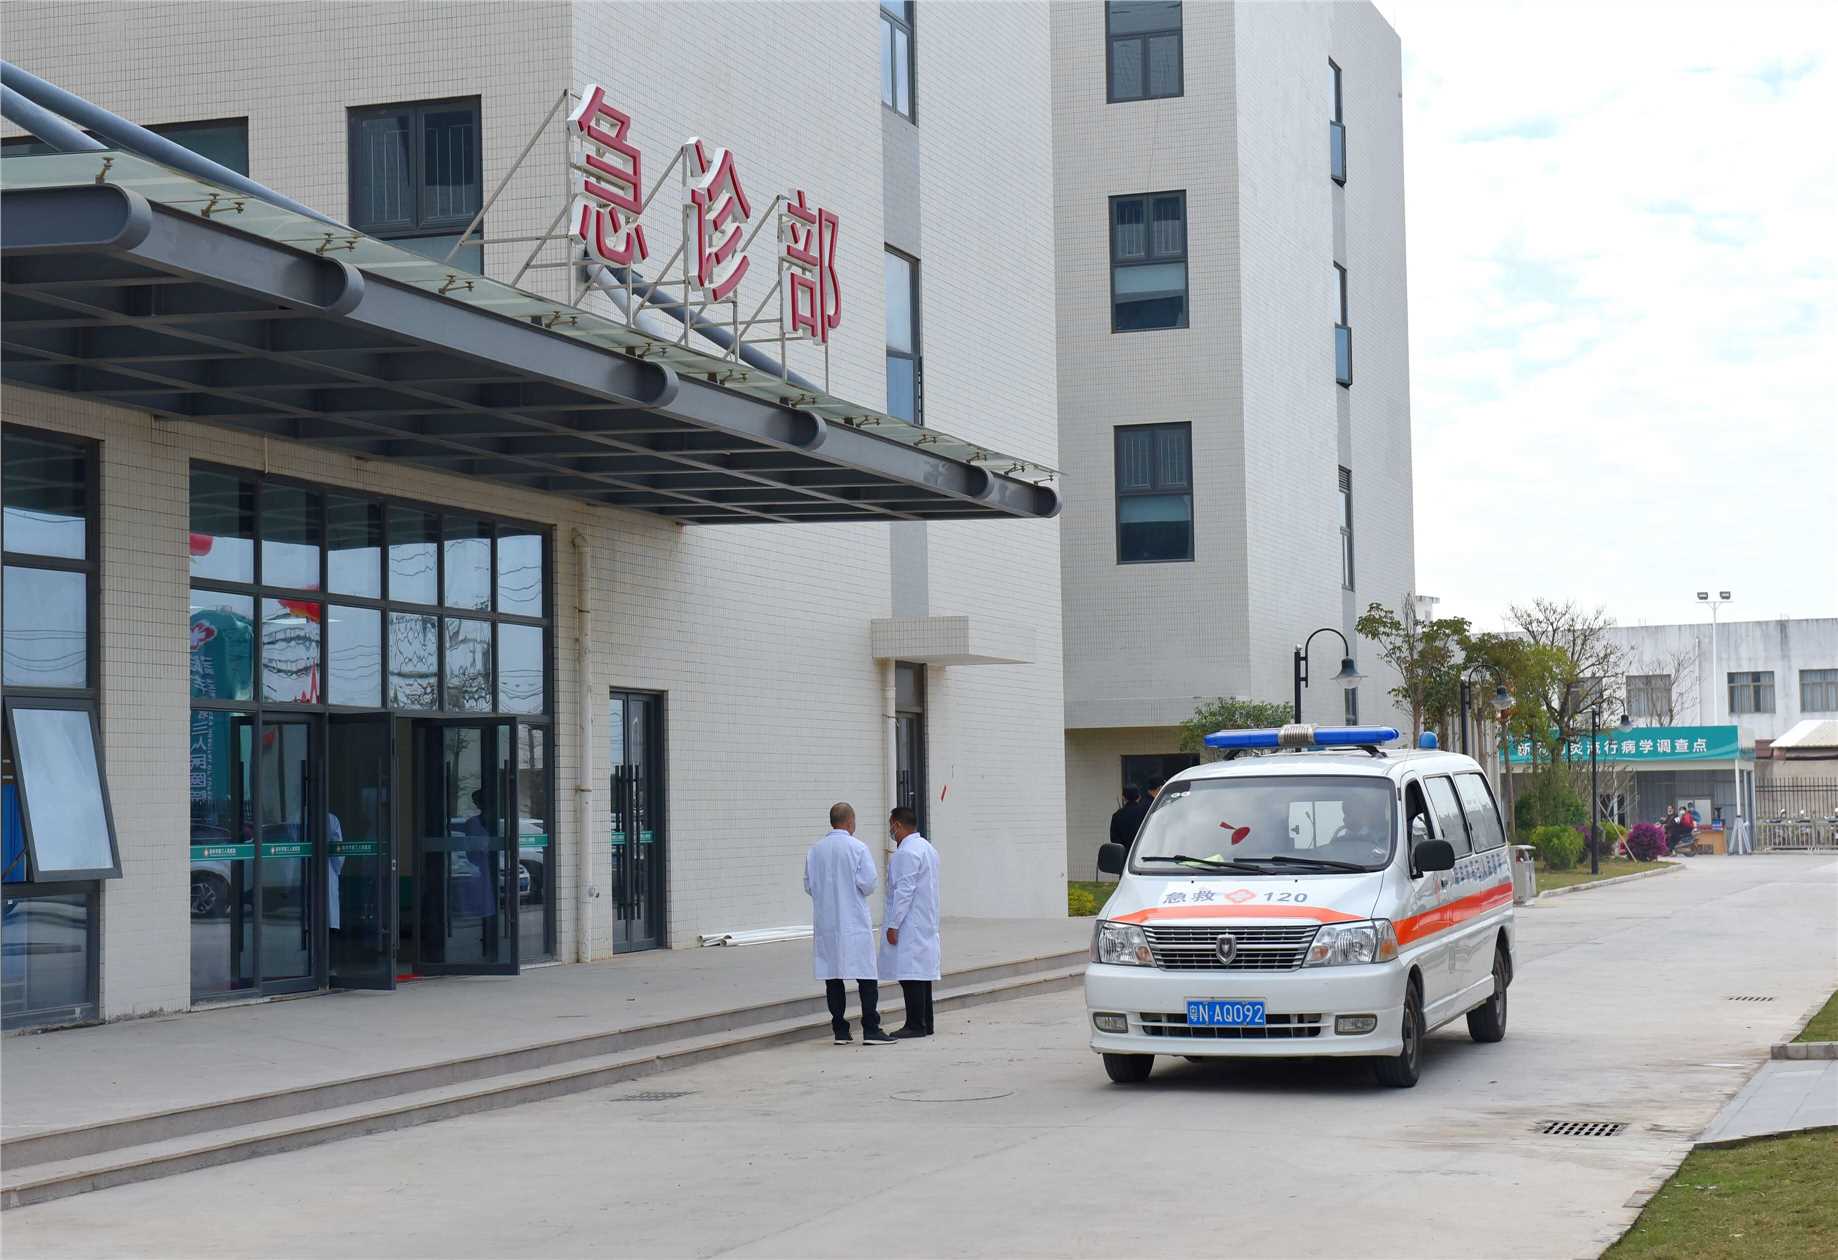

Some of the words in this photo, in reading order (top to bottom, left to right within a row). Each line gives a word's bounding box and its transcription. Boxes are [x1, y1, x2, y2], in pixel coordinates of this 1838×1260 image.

[567, 84, 842, 343] 急诊部
[1517, 738, 1708, 757] 新炎流行病学调查点
[1162, 888, 1217, 904] 急救
[1264, 892, 1309, 903] 120
